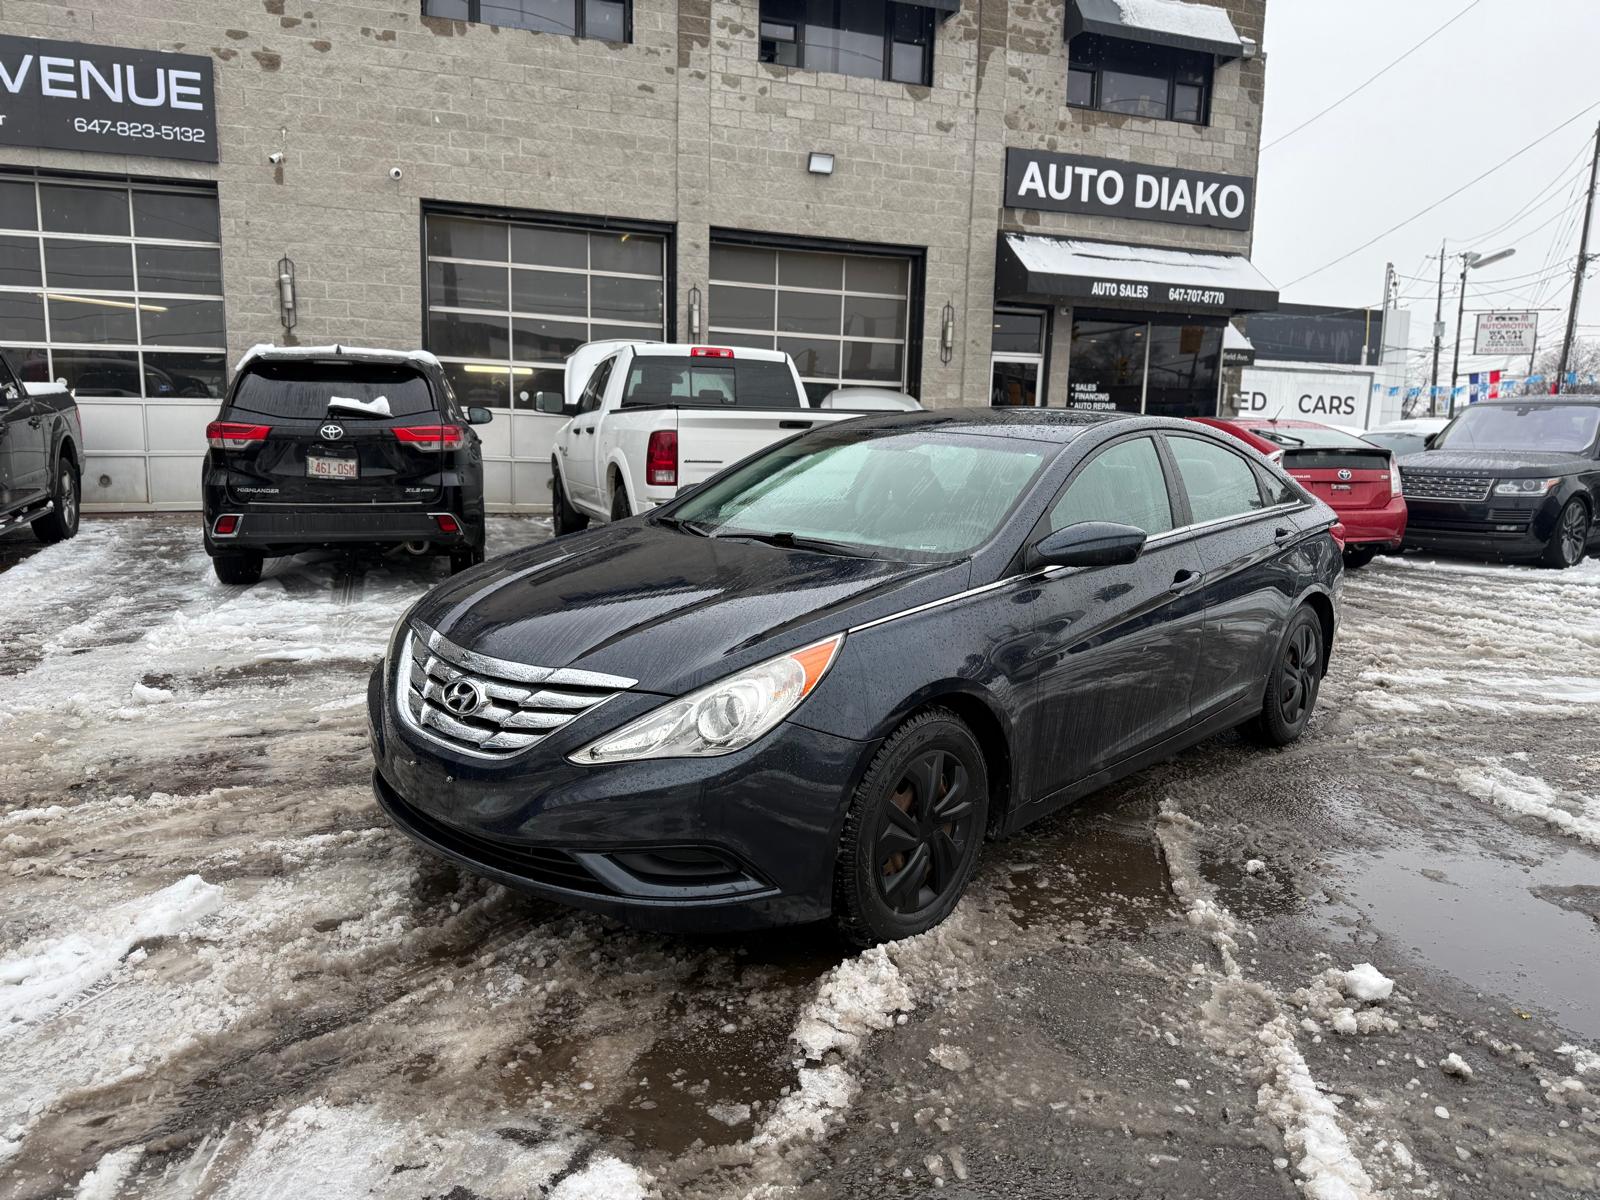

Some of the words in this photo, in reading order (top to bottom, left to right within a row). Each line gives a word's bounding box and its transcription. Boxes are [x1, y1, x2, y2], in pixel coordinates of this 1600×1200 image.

[0, 55, 203, 110] VENUE
[74, 117, 206, 143] 647-823-5132
[1017, 161, 1124, 206] AUTO
[1135, 174, 1245, 219] DIAKO
[1091, 282, 1118, 296] AUTO
[1119, 284, 1149, 299] SALES
[1168, 288, 1225, 304] 647-707-8770
[1480, 322, 1534, 330] AUTOMOTIVE
[1074, 392, 1110, 402] FINANCING
[1075, 383, 1097, 391] SALES
[1074, 402, 1092, 410] AUTO
[1093, 402, 1116, 410] REPAIR
[1298, 394, 1355, 415] CARS
